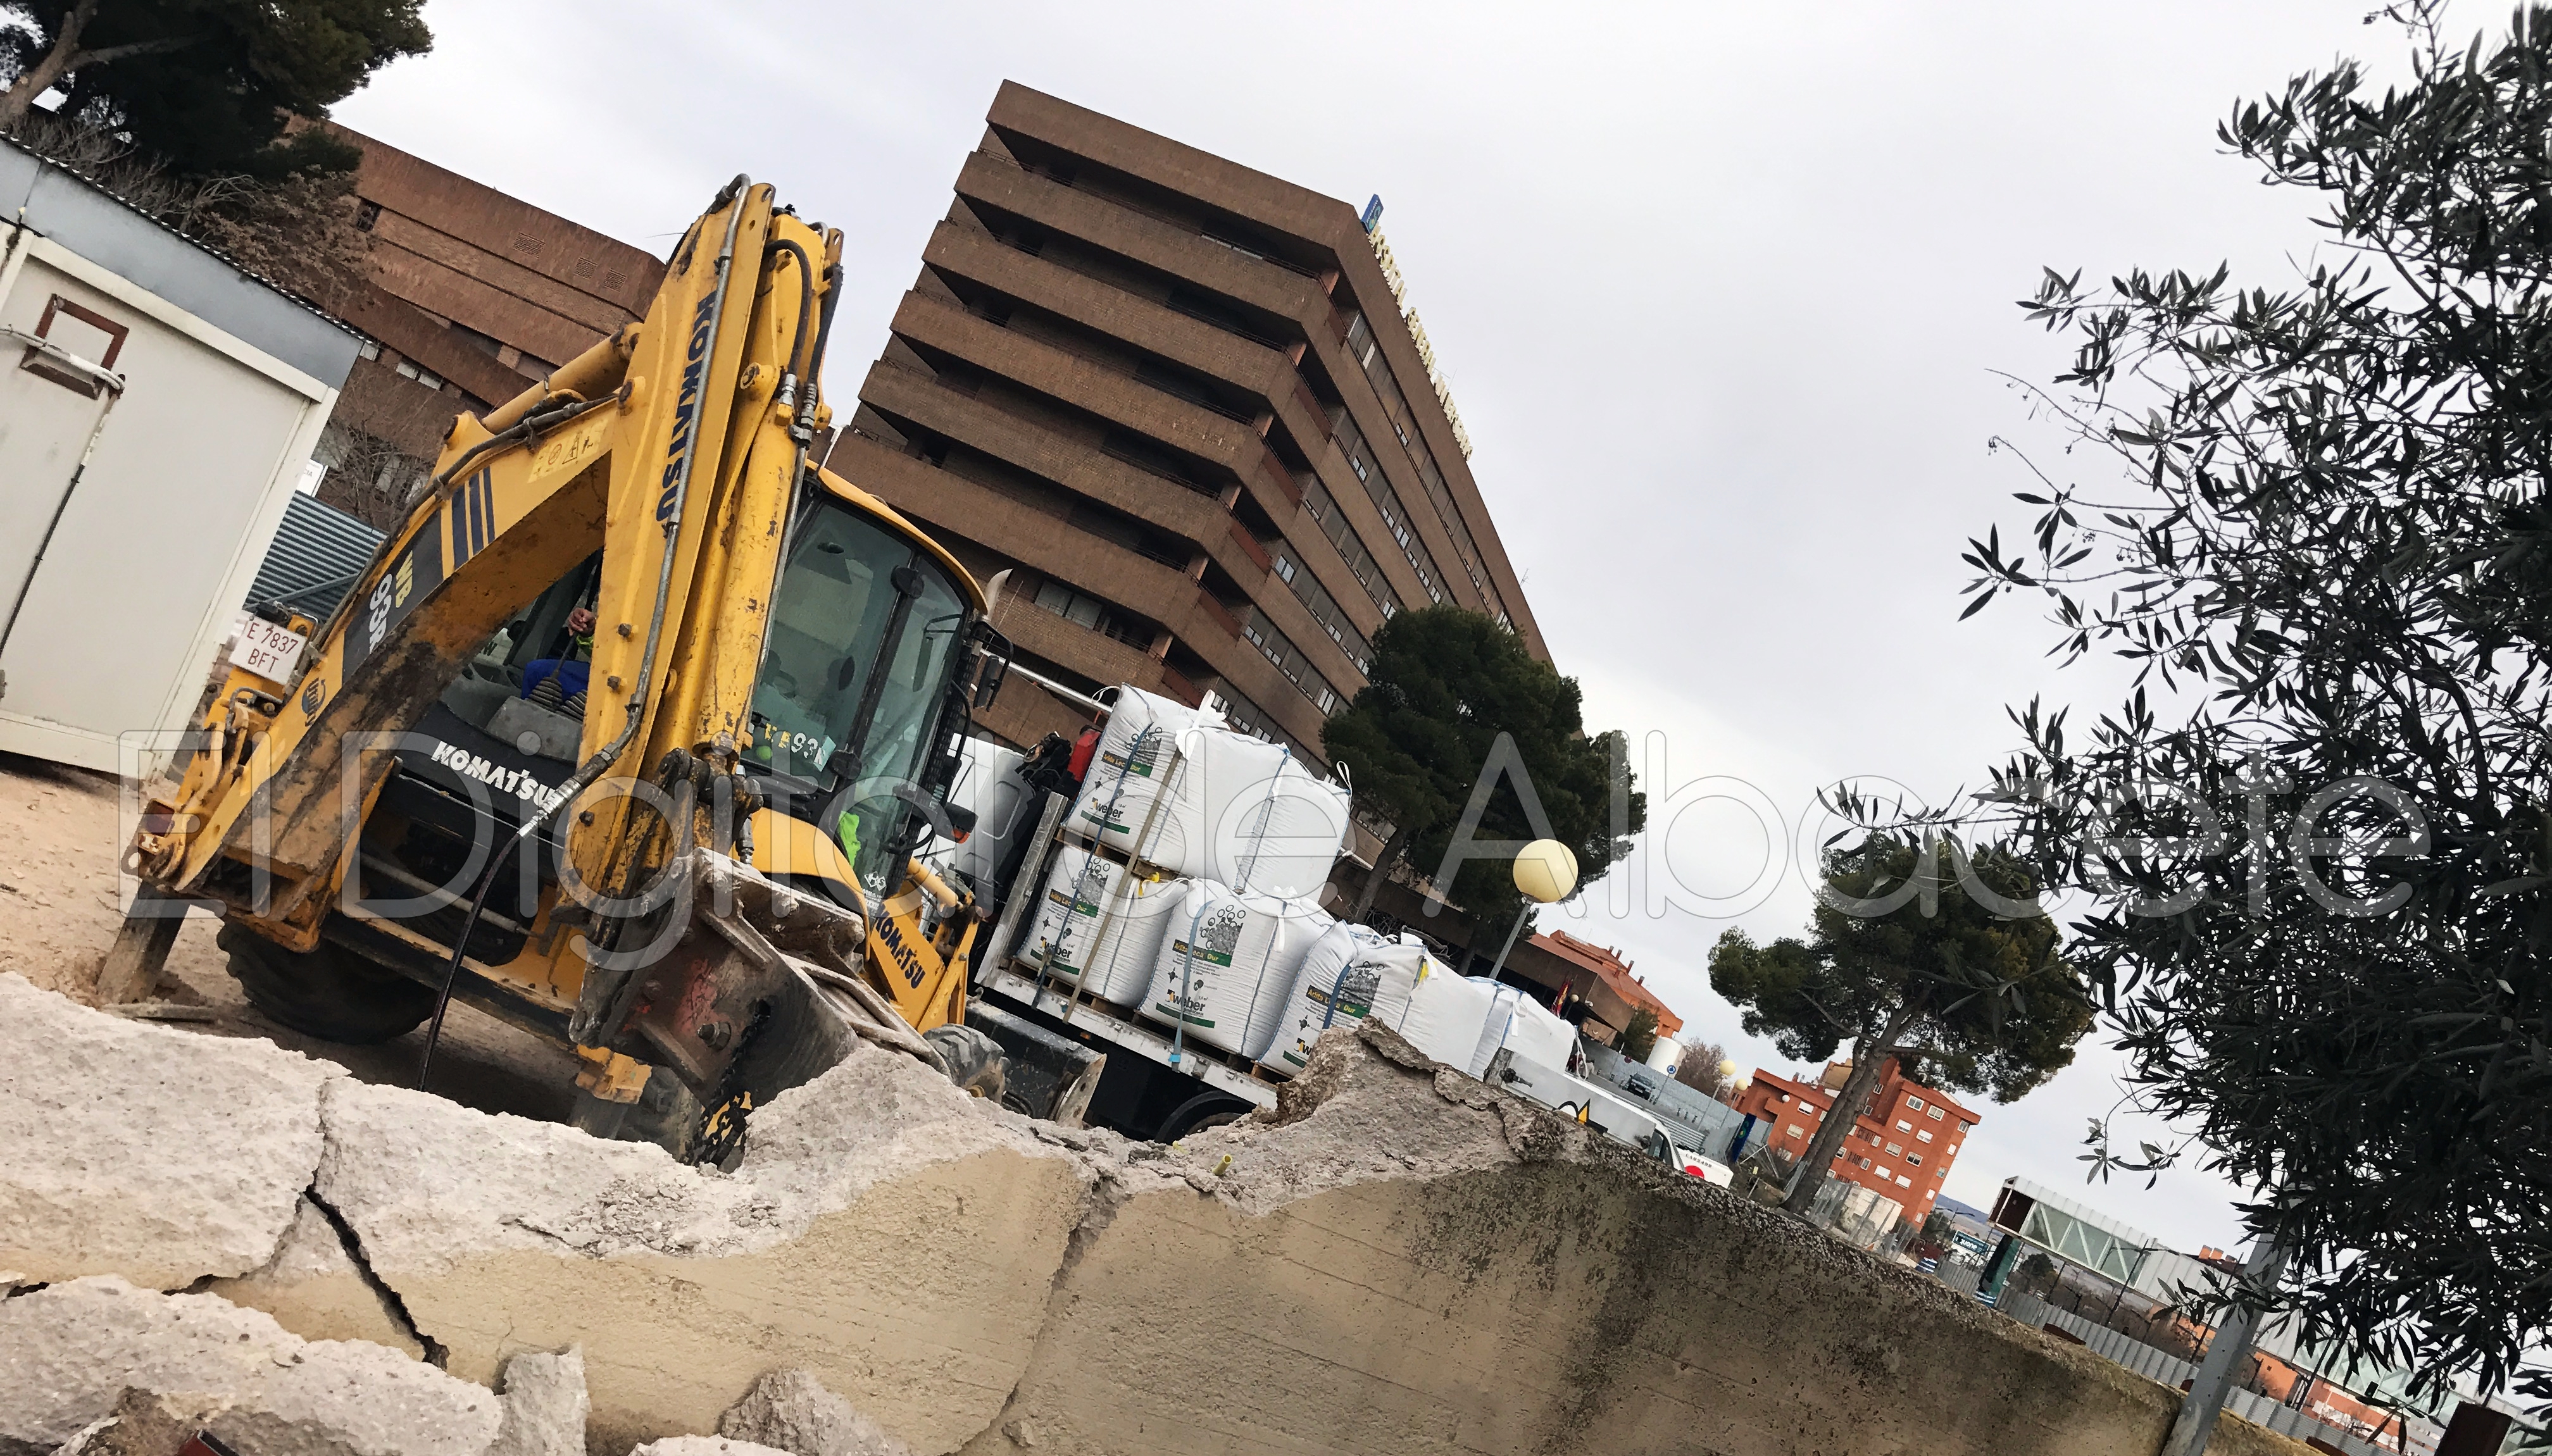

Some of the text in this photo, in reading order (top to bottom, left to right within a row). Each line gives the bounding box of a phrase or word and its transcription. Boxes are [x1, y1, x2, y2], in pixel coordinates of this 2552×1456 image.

[247, 621, 298, 655] E 7837
[247, 647, 279, 673] BFT
[431, 740, 556, 807] KOMATSU
[875, 904, 926, 989] KOMATSU
[1045, 940, 1073, 959] wber
[1206, 953, 1219, 961] Dur
[1343, 1004, 1356, 1014] Dur
